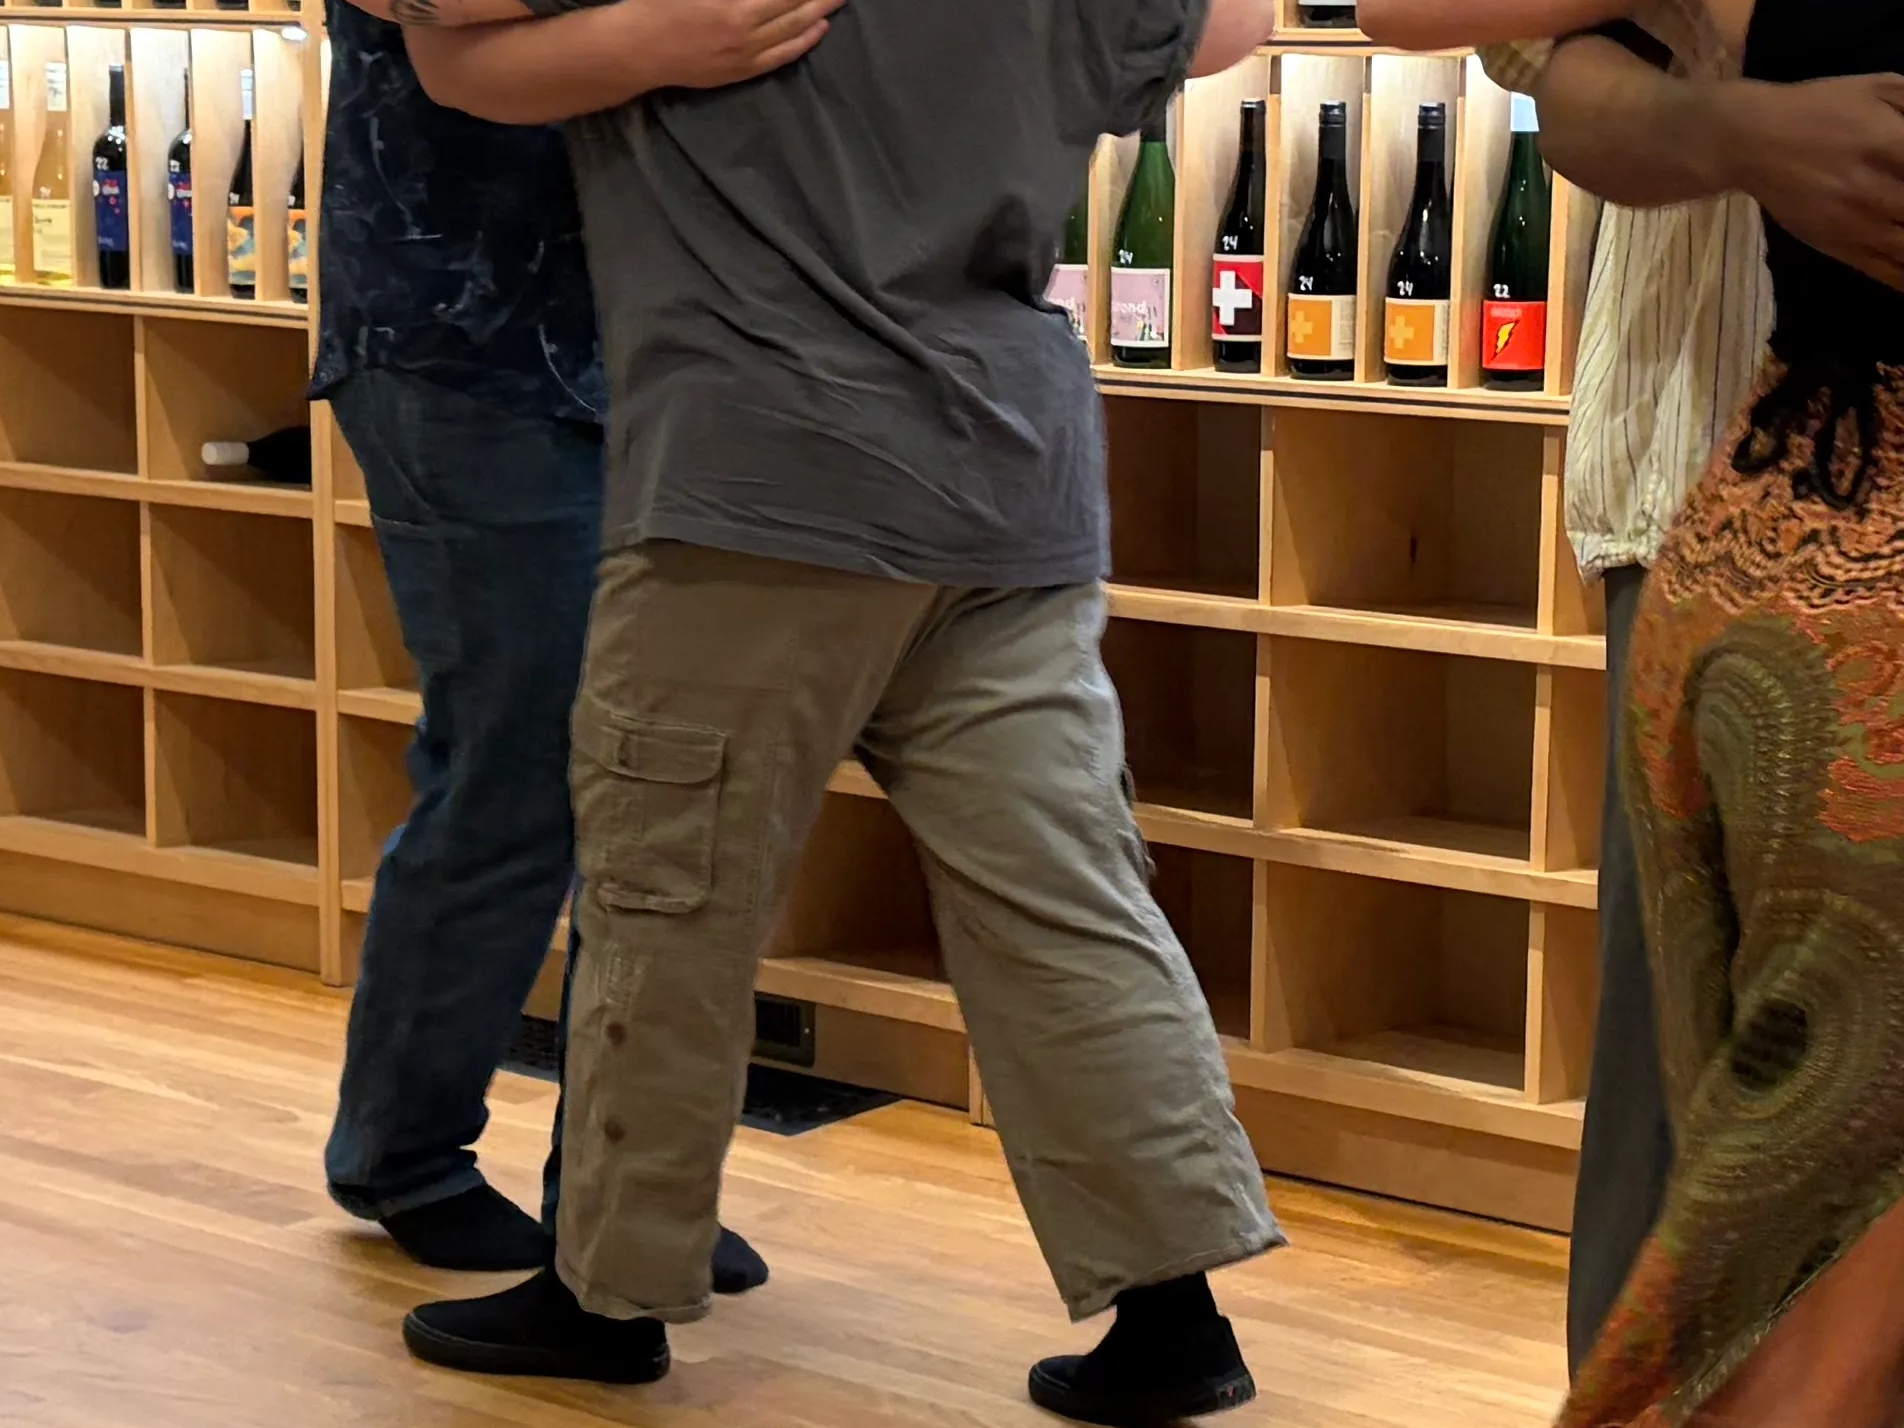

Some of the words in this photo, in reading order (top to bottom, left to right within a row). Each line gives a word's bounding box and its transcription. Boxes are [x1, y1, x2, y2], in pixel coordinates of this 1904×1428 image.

[1222, 235, 1238, 251] 24
[1397, 280, 1414, 296] 24
[1493, 283, 1511, 299] 22
